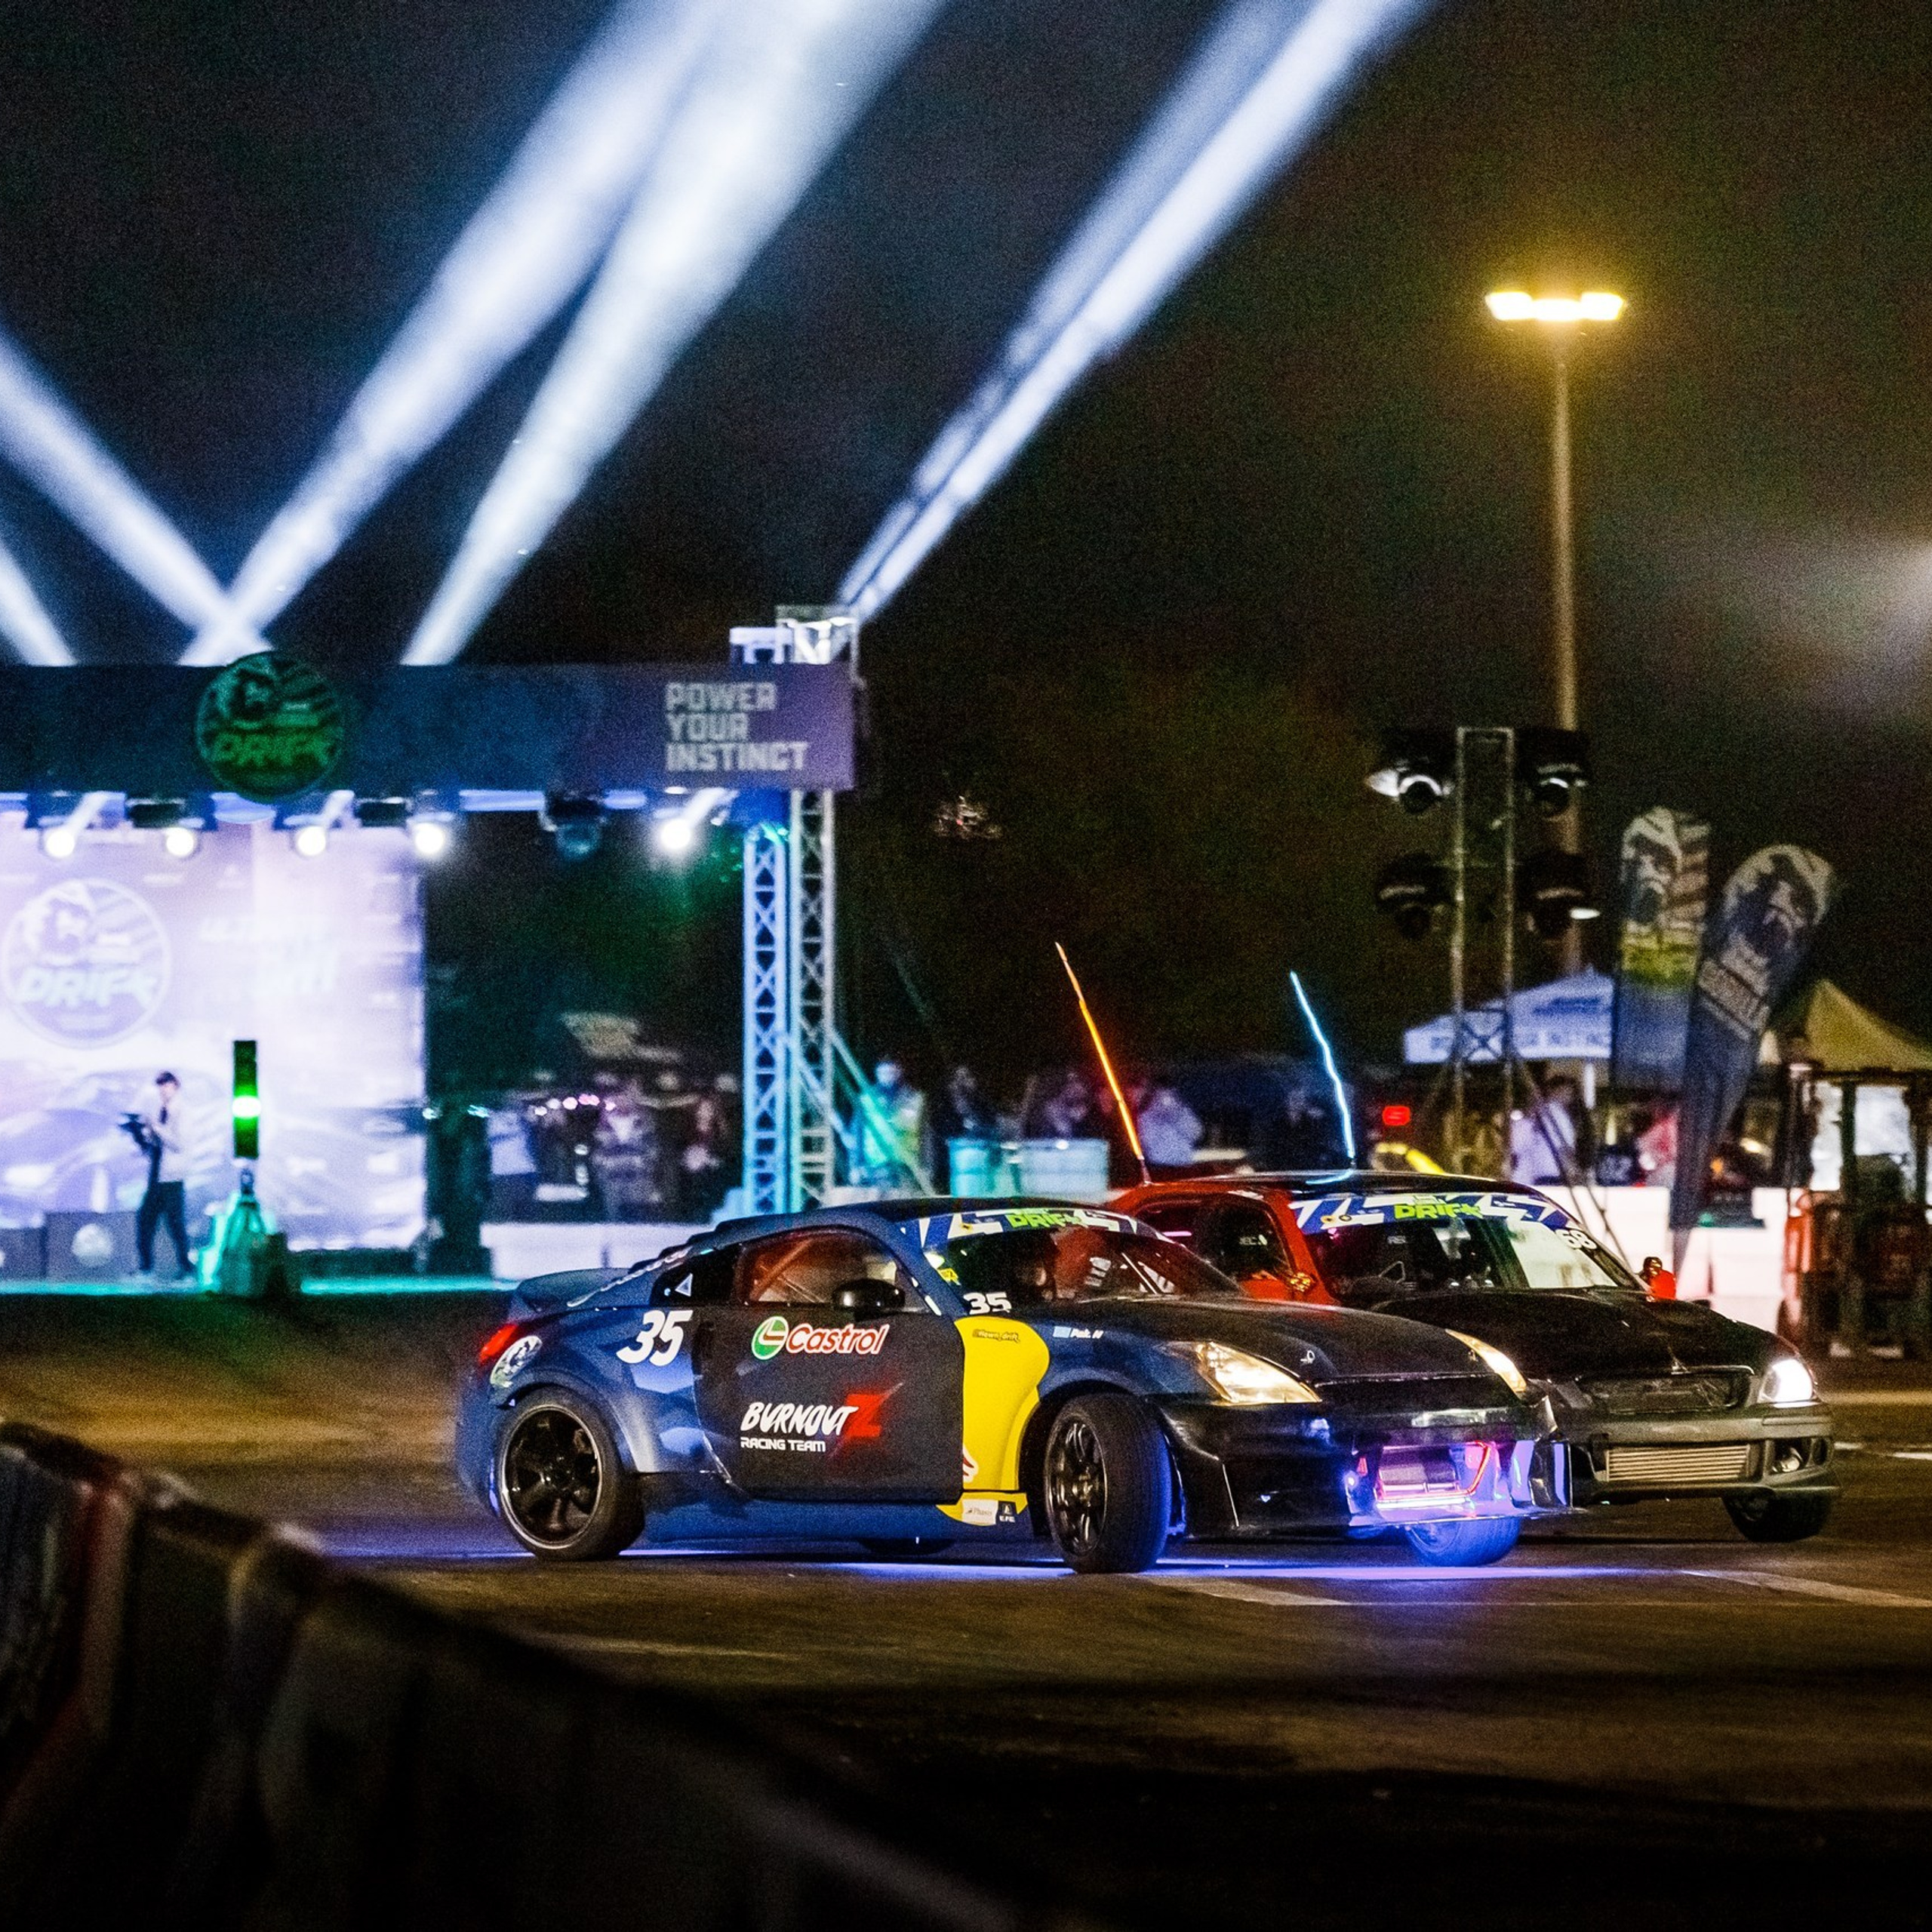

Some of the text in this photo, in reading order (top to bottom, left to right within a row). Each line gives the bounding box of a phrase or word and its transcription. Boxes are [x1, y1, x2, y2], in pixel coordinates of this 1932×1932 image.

[666, 682, 777, 711] POWER
[667, 712, 749, 741] YOUR
[667, 741, 808, 771] INSTINCT
[963, 1291, 1012, 1315] 35
[616, 1309, 694, 1367] 35
[786, 1323, 891, 1355] Castrol
[740, 1437, 826, 1453] RACING TEAM
